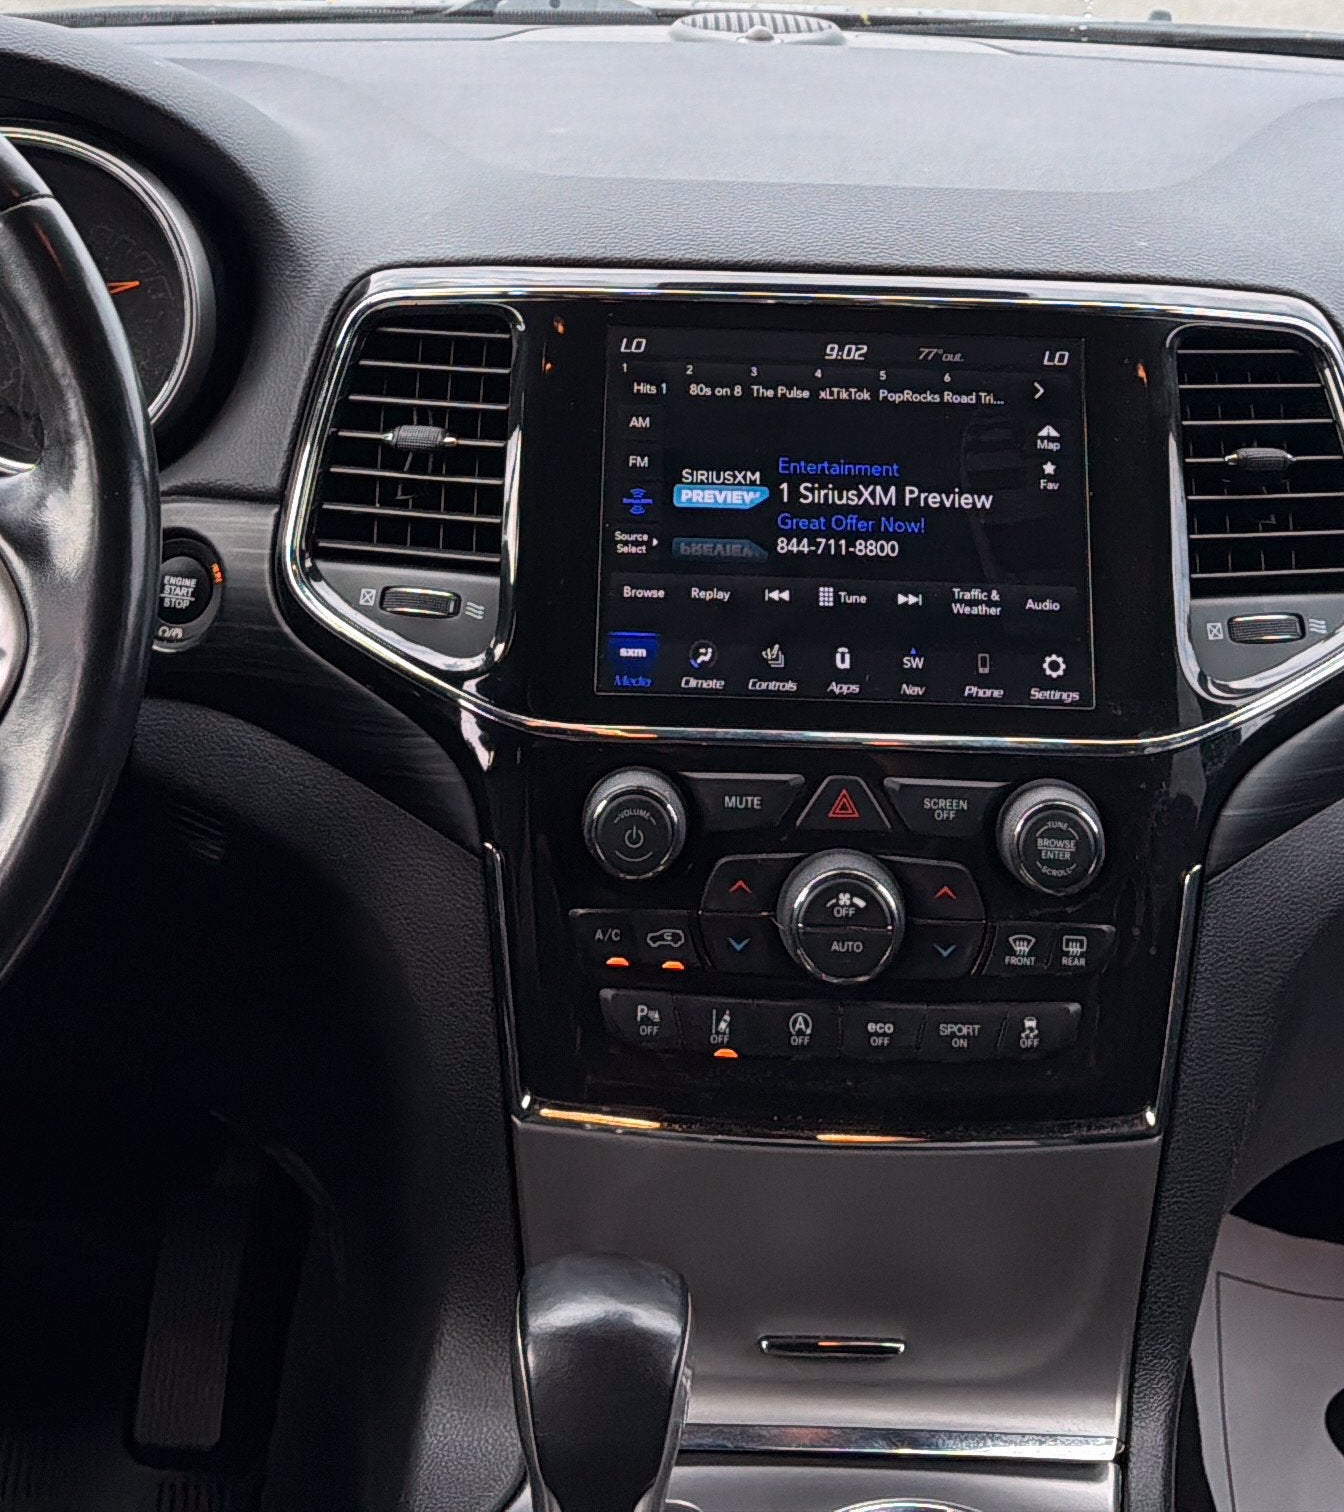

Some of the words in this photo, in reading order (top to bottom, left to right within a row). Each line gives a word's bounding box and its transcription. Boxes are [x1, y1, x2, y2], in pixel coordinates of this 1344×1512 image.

[620, 337, 647, 353] LO
[824, 343, 868, 361] 9:02
[1043, 350, 1069, 366] LO
[622, 363, 628, 373] 1
[686, 364, 693, 375] 2
[751, 366, 758, 377] 3
[814, 368, 822, 379] 4
[879, 370, 887, 381] 5
[944, 372, 951, 383] 6
[634, 382, 657, 395] Hits
[661, 383, 667, 395] 1
[689, 384, 711, 396] 80s
[715, 387, 731, 397] on
[734, 385, 742, 397] 8
[751, 385, 774, 398] The
[777, 386, 810, 399] Pulse
[879, 389, 940, 404] PopRocks
[944, 391, 976, 404] Road
[629, 416, 650, 428] AM
[1037, 439, 1061, 452] Map
[628, 456, 649, 468] FM
[778, 457, 900, 477] Entertainment
[1040, 479, 1059, 491] Fav
[681, 490, 761, 504] PREVIEW
[779, 482, 789, 503] 1
[799, 483, 896, 506] SiriusXM
[905, 487, 993, 509] Preview
[777, 513, 826, 530] Great
[831, 515, 875, 532] Offer
[881, 517, 926, 533] Now!
[614, 531, 649, 542] Source
[616, 543, 647, 554] Select
[776, 537, 899, 557] 844-711-8800
[163, 575, 197, 588] ENGINE
[163, 584, 194, 597] START
[623, 586, 665, 598] Browse
[691, 587, 731, 602] Replay
[952, 588, 988, 601] Traffic
[990, 589, 1000, 601] &
[163, 598, 190, 609] STOP
[838, 591, 867, 604] Tune
[952, 603, 1002, 616] Weather
[1025, 599, 1060, 611] Audio
[619, 647, 647, 658] sxm
[902, 656, 924, 669] SW
[613, 675, 651, 687] Media
[681, 676, 725, 689] Climate
[748, 678, 798, 692] Controls
[827, 681, 860, 695] Apps
[900, 684, 926, 696] Nav
[964, 686, 1004, 698] Phone
[1030, 688, 1080, 703] Settings
[724, 796, 762, 809] MUTE
[923, 798, 968, 810] SCREEN
[618, 808, 651, 820] VOLUME
[934, 810, 956, 821] OFF
[1047, 821, 1069, 831] TUNE
[1037, 838, 1076, 849] BROWSE
[1041, 850, 1071, 860] ENTER
[1040, 866, 1073, 878] SCROLL
[833, 907, 856, 918] OFF
[594, 929, 621, 941] A/C
[831, 941, 863, 953] AUTO
[1005, 956, 1036, 966] FRONT
[1061, 956, 1086, 967] REAR
[639, 1026, 660, 1036] OFF
[867, 1023, 894, 1033] eco
[939, 1024, 981, 1036] SPORT
[710, 1034, 730, 1044] OFF
[791, 1036, 810, 1046] OFF
[870, 1037, 890, 1047] OFF
[951, 1038, 968, 1048] ON
[1020, 1038, 1039, 1048] OFF
